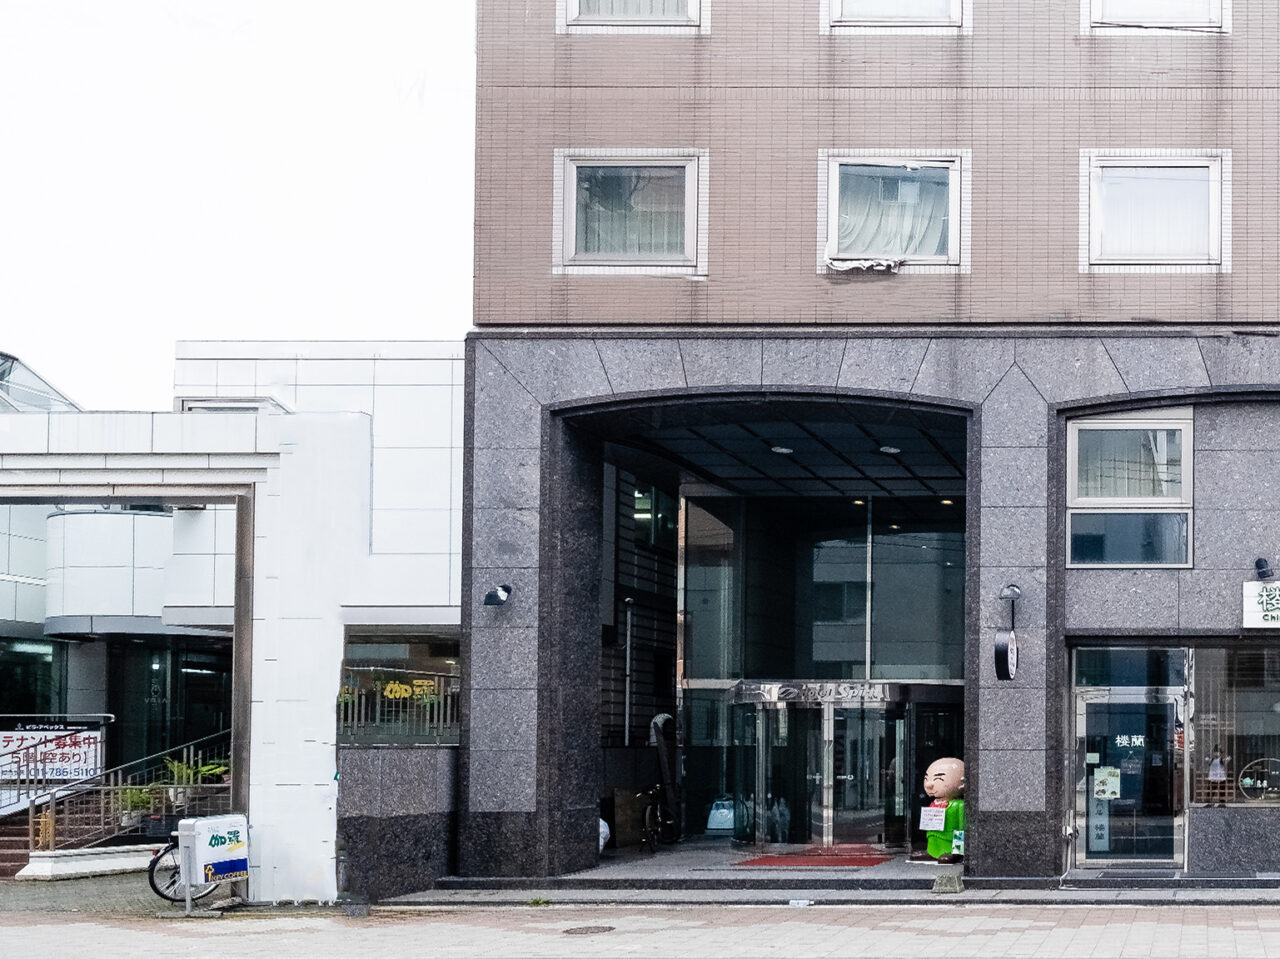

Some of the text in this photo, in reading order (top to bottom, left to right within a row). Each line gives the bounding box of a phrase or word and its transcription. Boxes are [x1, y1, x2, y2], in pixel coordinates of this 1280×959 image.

[2, 734, 97, 749] テナント募集中
[1115, 734, 1146, 747] 楼蘭
